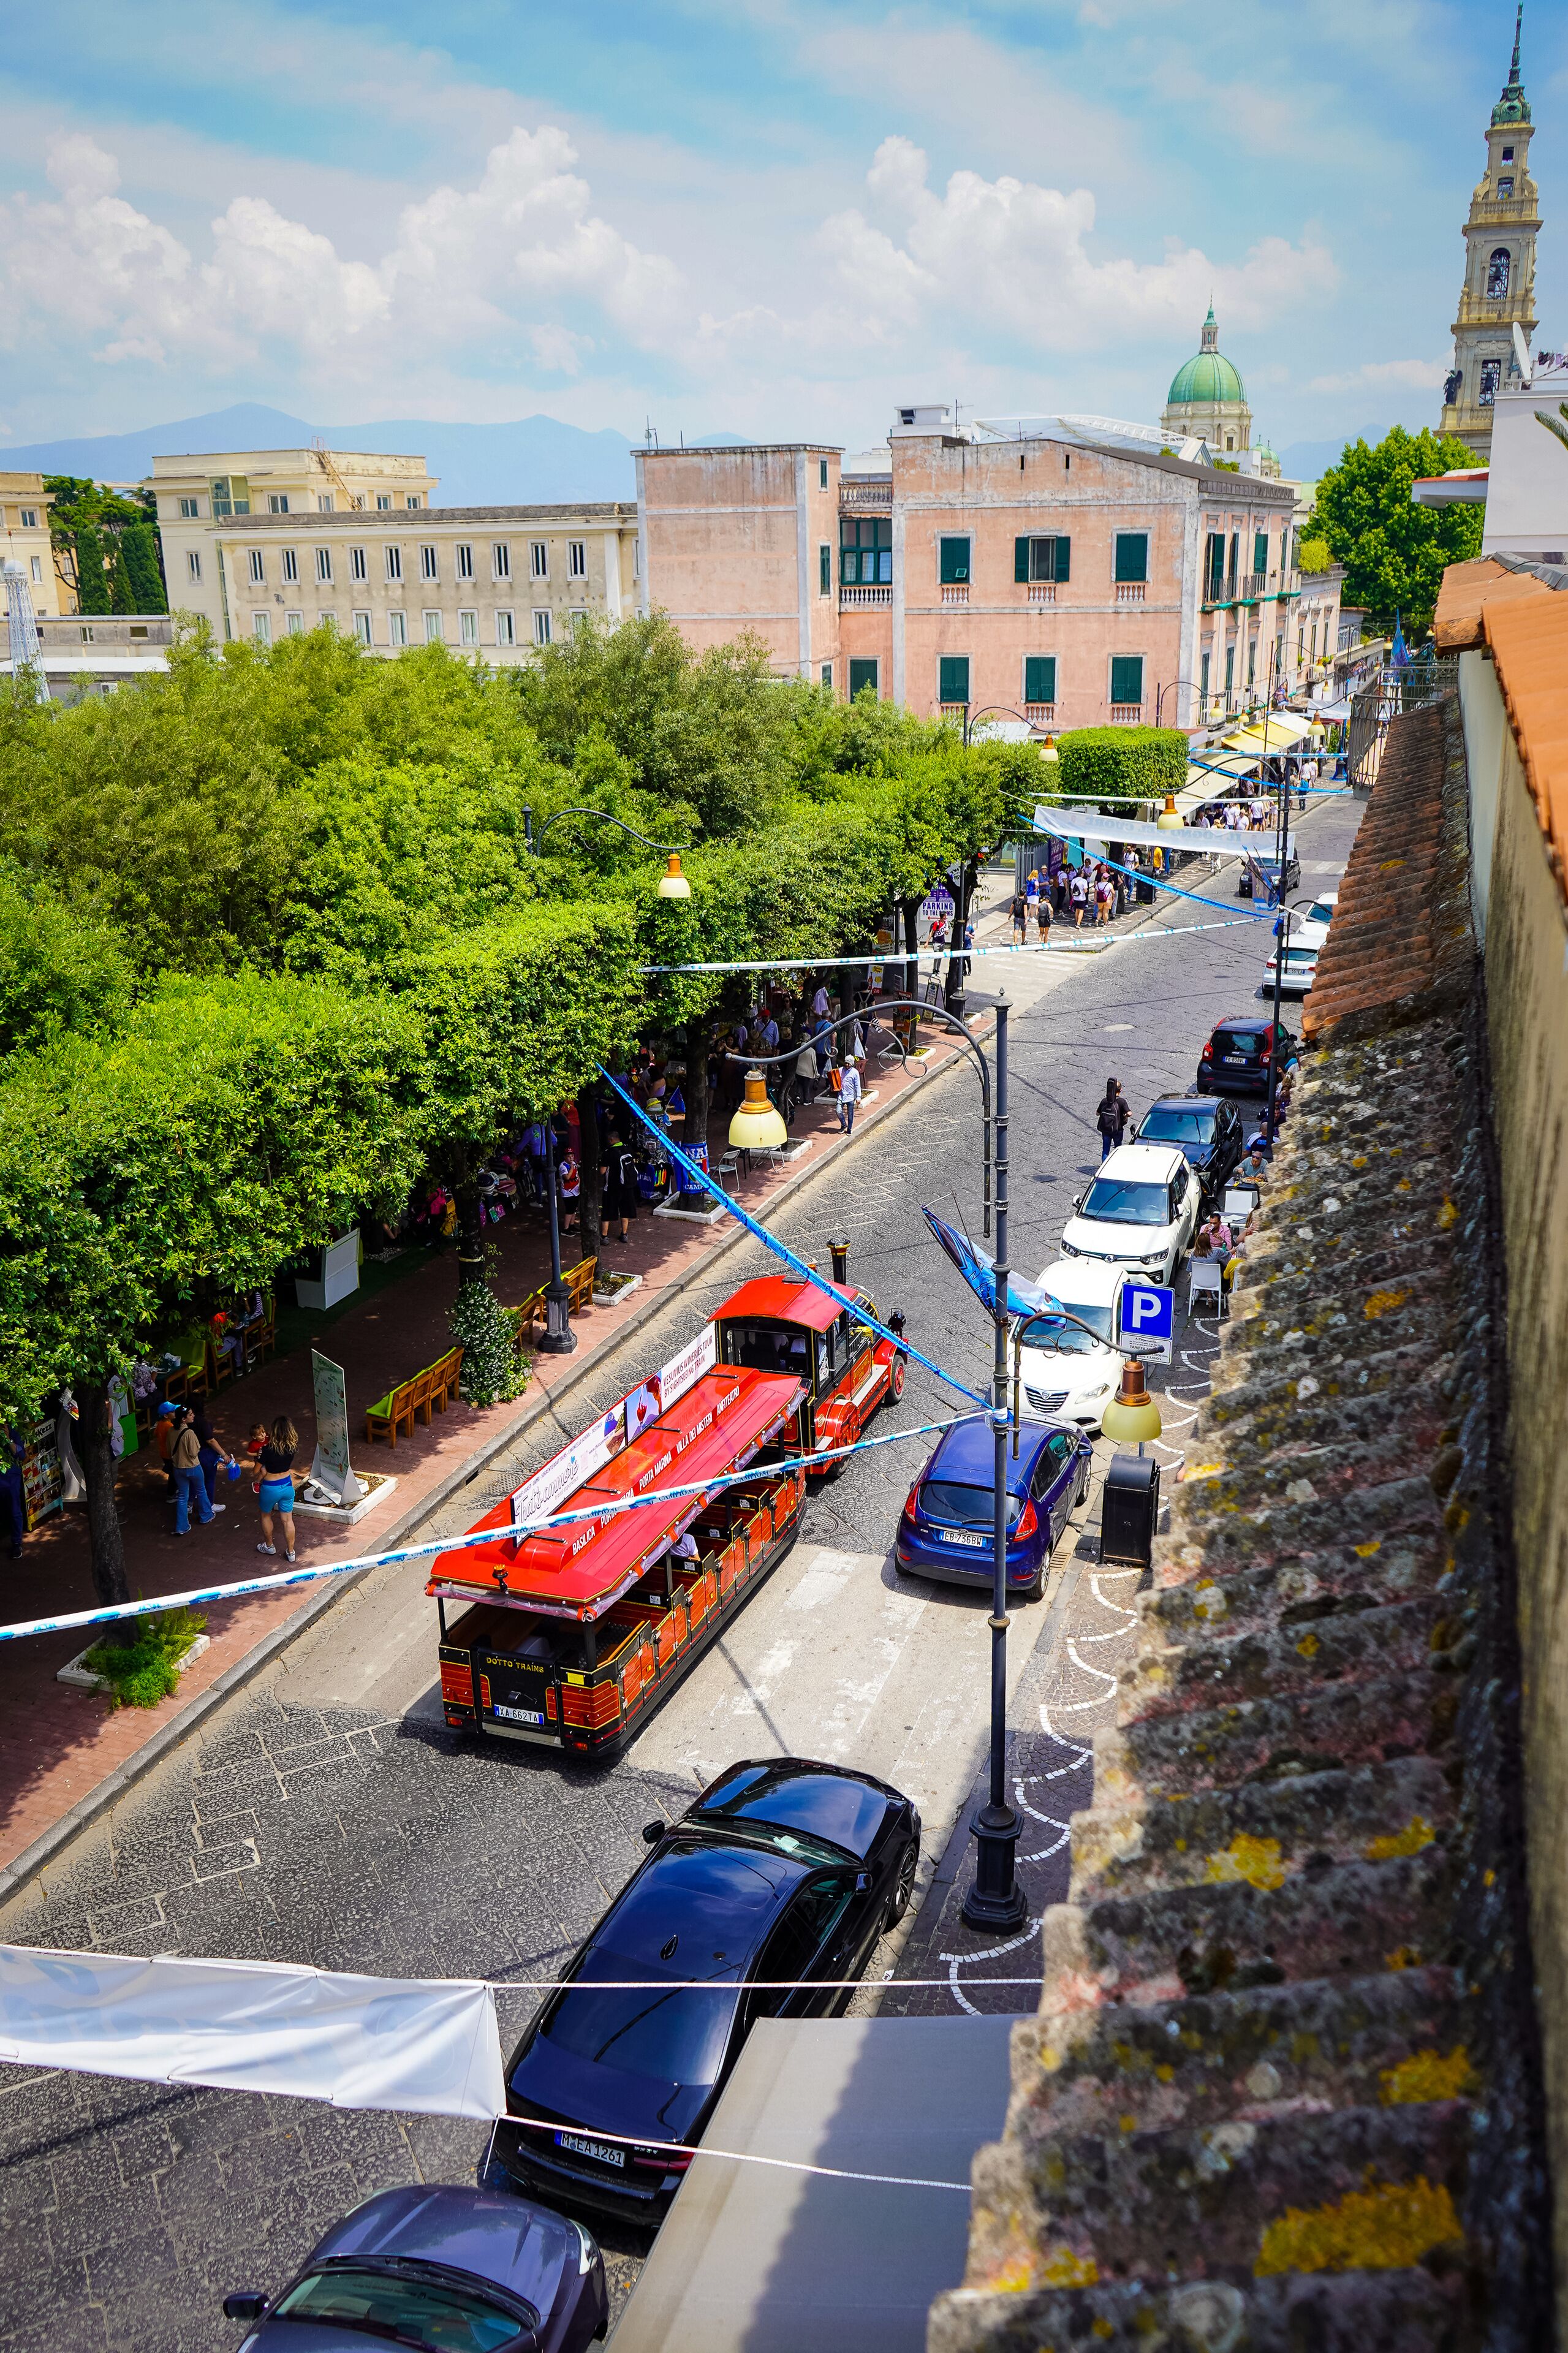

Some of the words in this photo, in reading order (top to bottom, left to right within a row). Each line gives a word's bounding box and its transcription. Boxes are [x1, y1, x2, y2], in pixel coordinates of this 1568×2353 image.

[922, 902, 953, 911] PARKING
[1132, 1290, 1162, 1328] P
[664, 1362, 683, 1387] VESUVIUS
[684, 1345, 702, 1369] WINERIES
[703, 1335, 713, 1351] TOUR
[664, 1387, 670, 1398] BY
[670, 1366, 694, 1393] SIGHTSEEING
[694, 1354, 705, 1373] TRAIN
[572, 1526, 596, 1556] BASILICA
[639, 1472, 654, 1489] PORTA
[654, 1450, 672, 1479] MARINA
[676, 1439, 689, 1455] VILLA
[689, 1428, 697, 1442] DEI
[696, 1411, 713, 1434] MISTERI
[716, 1385, 740, 1415] ANFITEATRO
[486, 1657, 513, 1668] DOTTO
[515, 1662, 544, 1673] TRAINS
[593, 2144, 623, 2165] 1261
